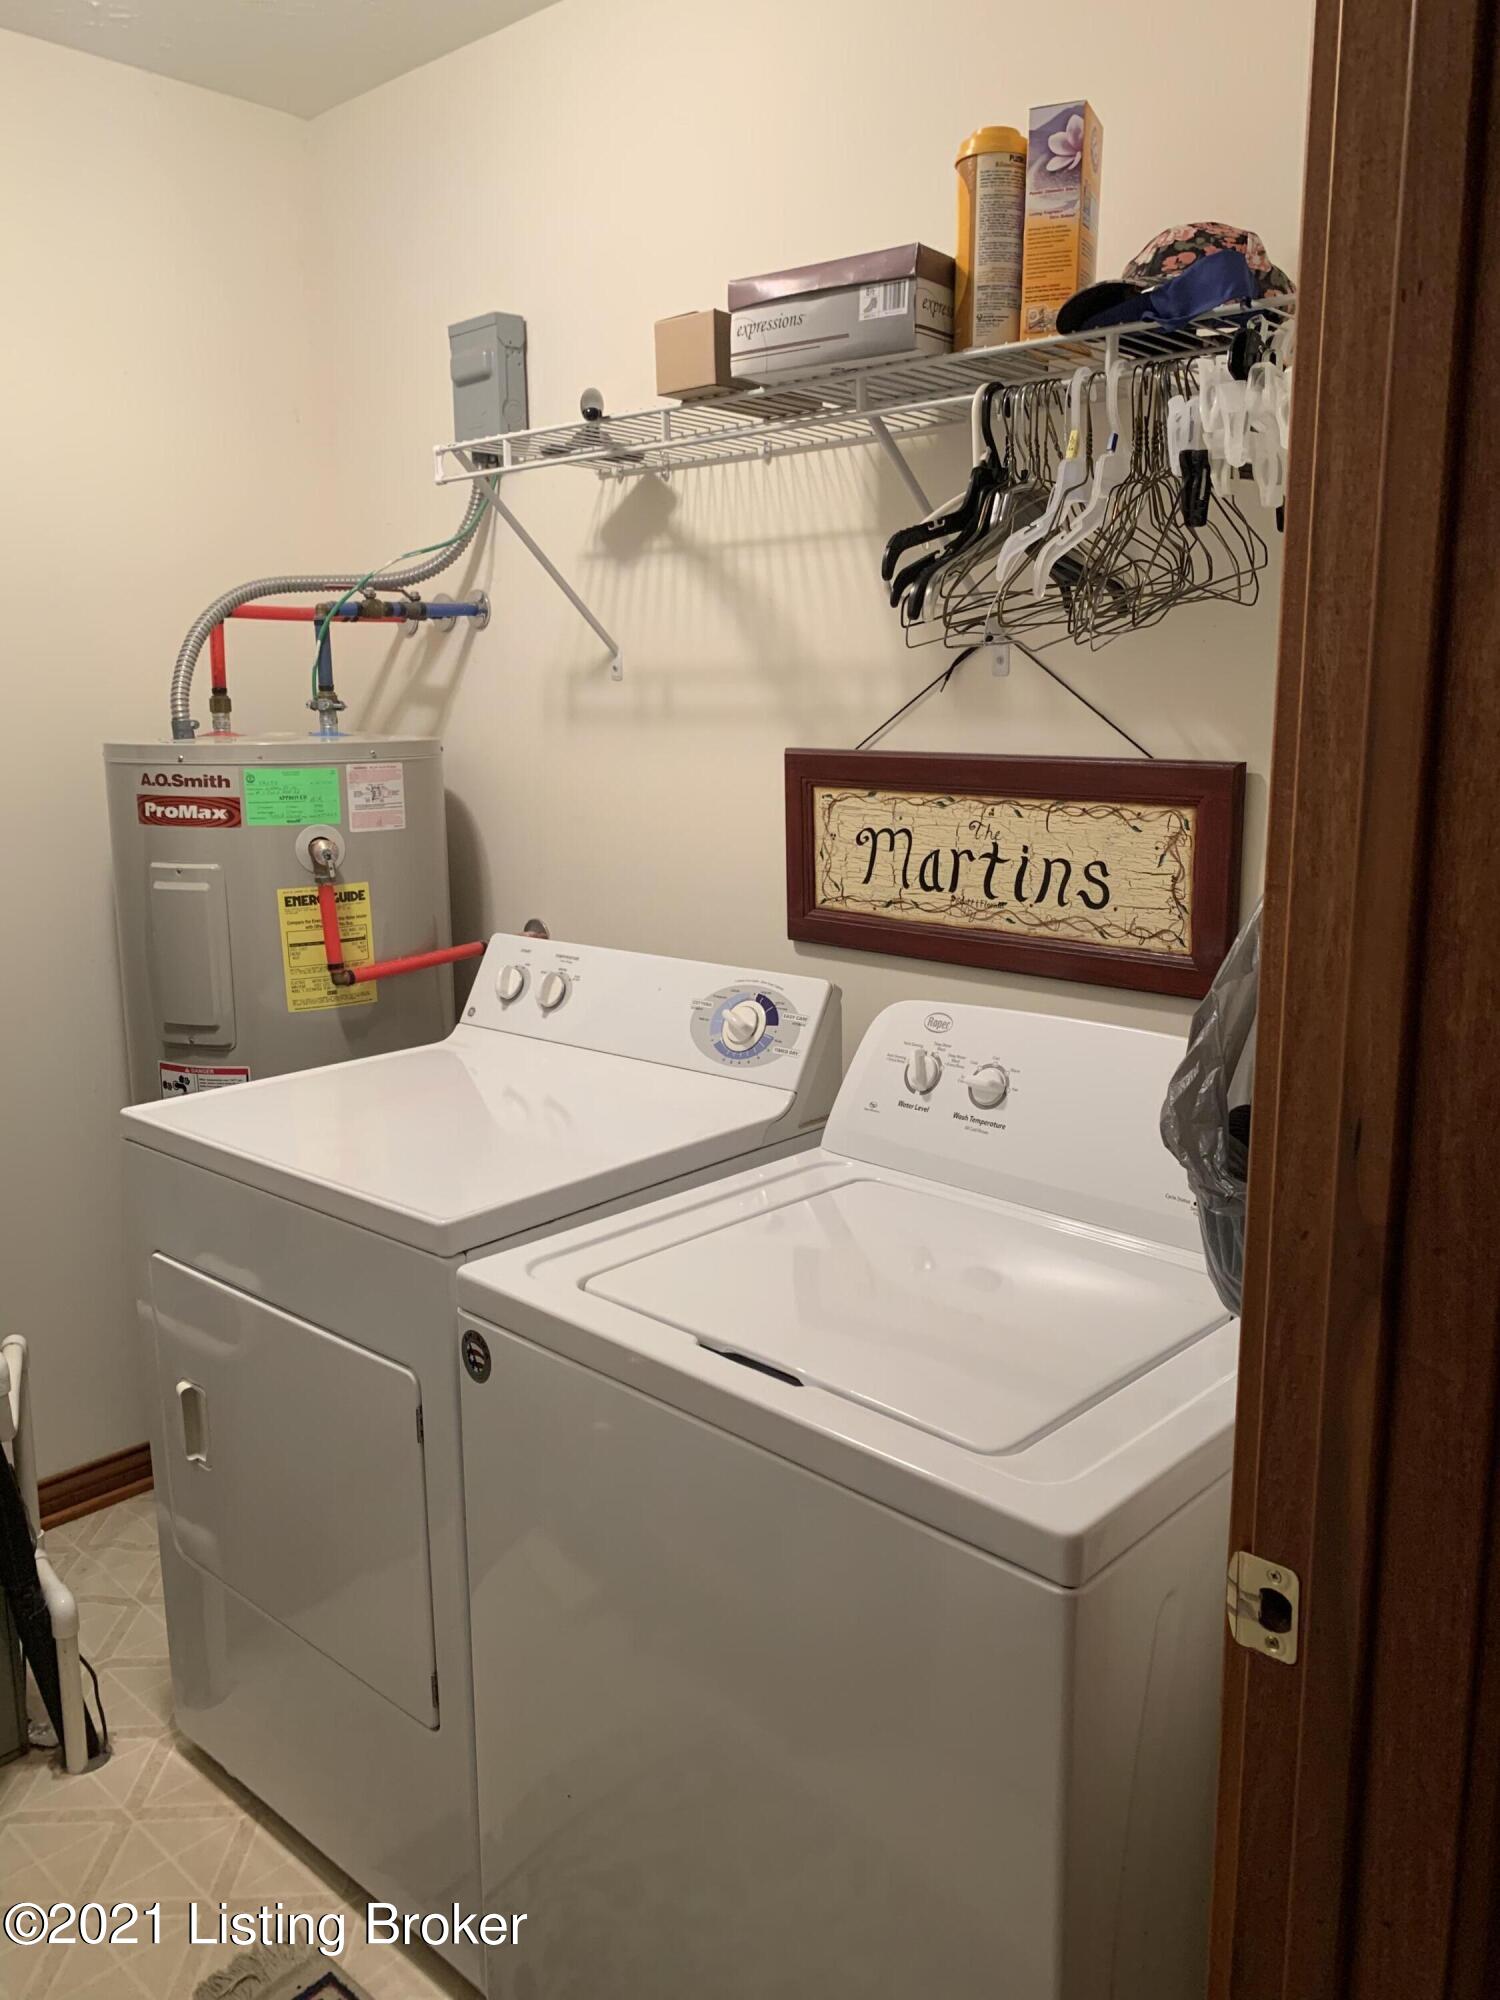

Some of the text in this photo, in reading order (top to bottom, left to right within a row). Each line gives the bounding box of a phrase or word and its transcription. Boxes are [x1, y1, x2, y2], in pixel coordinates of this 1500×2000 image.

[736, 311, 804, 340] expressions
[144, 802, 229, 819] ProMax
[968, 820, 1002, 841] The
[856, 828, 1111, 910] Martins
[914, 1104, 930, 1113] Level
[952, 1112, 1006, 1130] Wash Temperature
